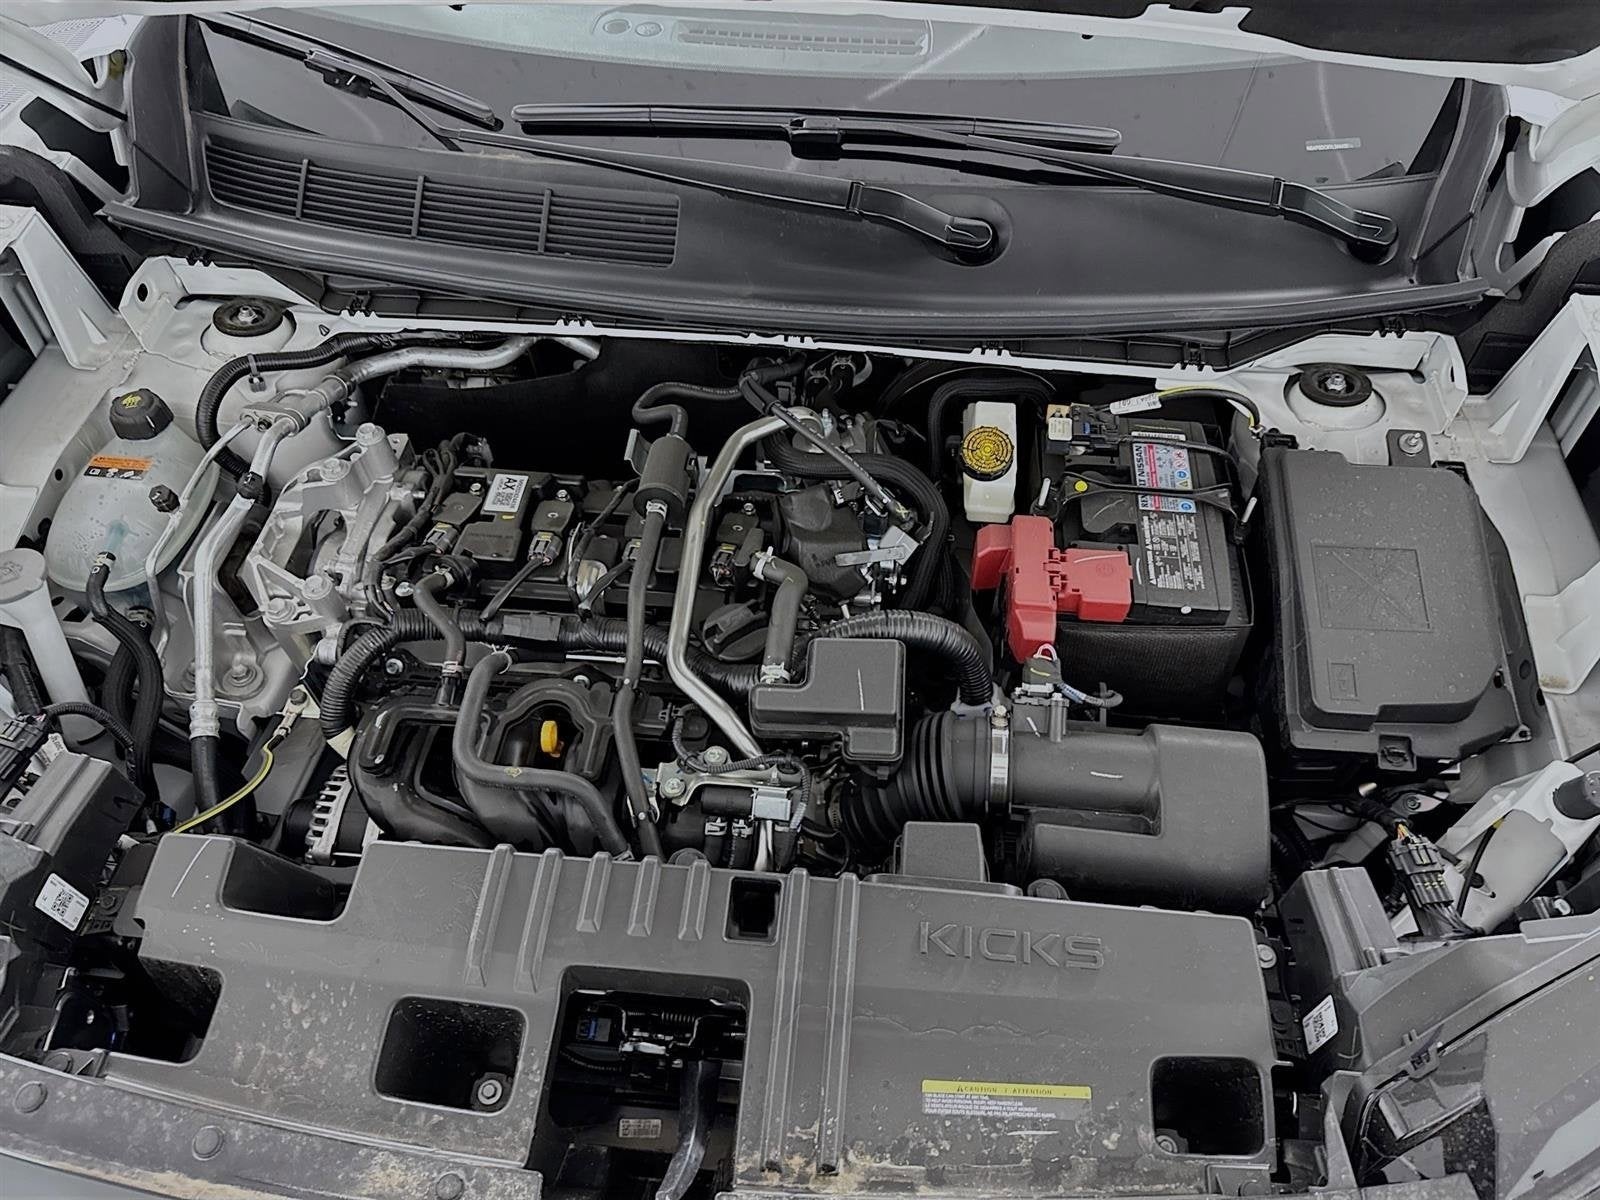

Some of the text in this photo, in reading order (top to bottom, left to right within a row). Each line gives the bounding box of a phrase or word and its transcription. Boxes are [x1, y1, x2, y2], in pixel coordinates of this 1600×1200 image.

[1135, 445, 1145, 477] NISSAN
[502, 477, 518, 491] AX
[919, 921, 1105, 970] KICKS
[964, 1086, 998, 1094] CAUTION
[1012, 1087, 1053, 1096] ATTENTION
